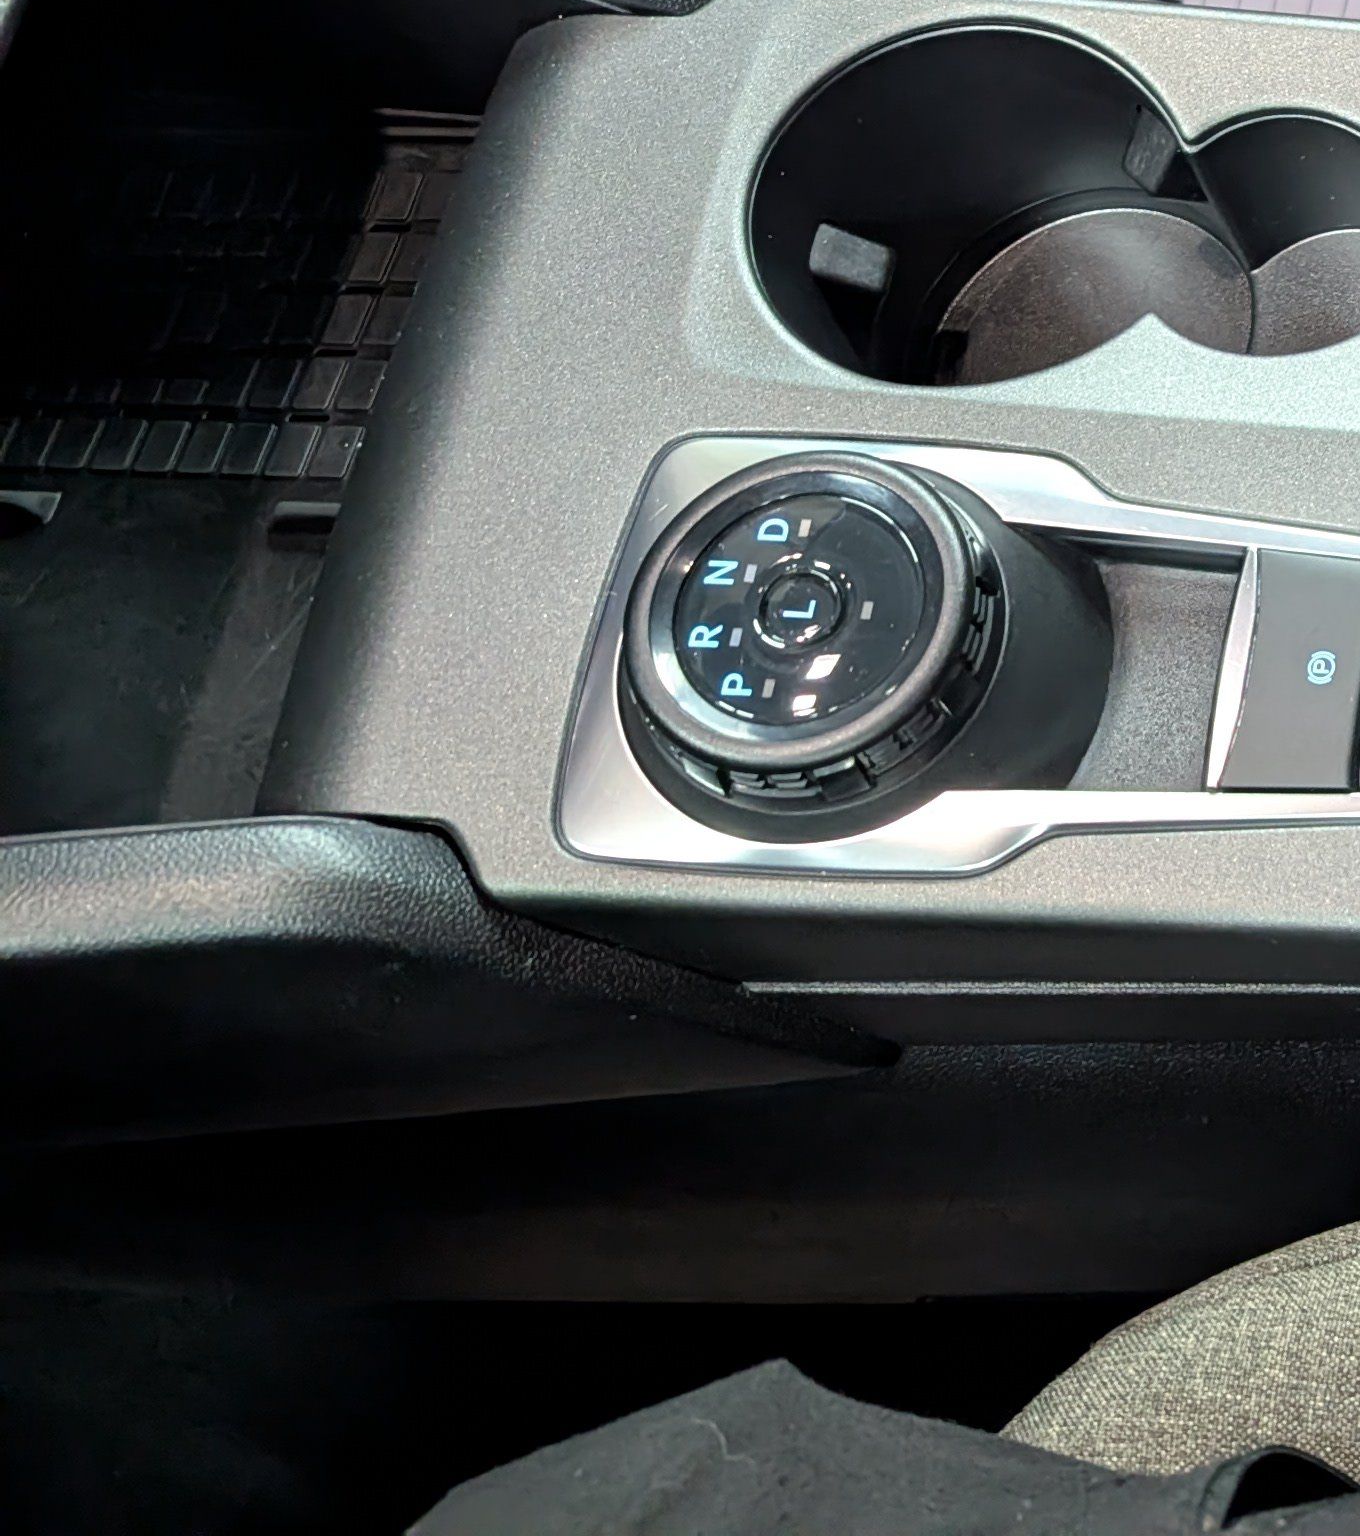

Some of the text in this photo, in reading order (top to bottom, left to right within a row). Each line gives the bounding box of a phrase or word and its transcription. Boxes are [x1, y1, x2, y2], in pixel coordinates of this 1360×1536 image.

[757, 518, 790, 543] D
[703, 559, 739, 585] N
[783, 599, 817, 619] L
[688, 624, 724, 648] R
[720, 672, 752, 696] P
